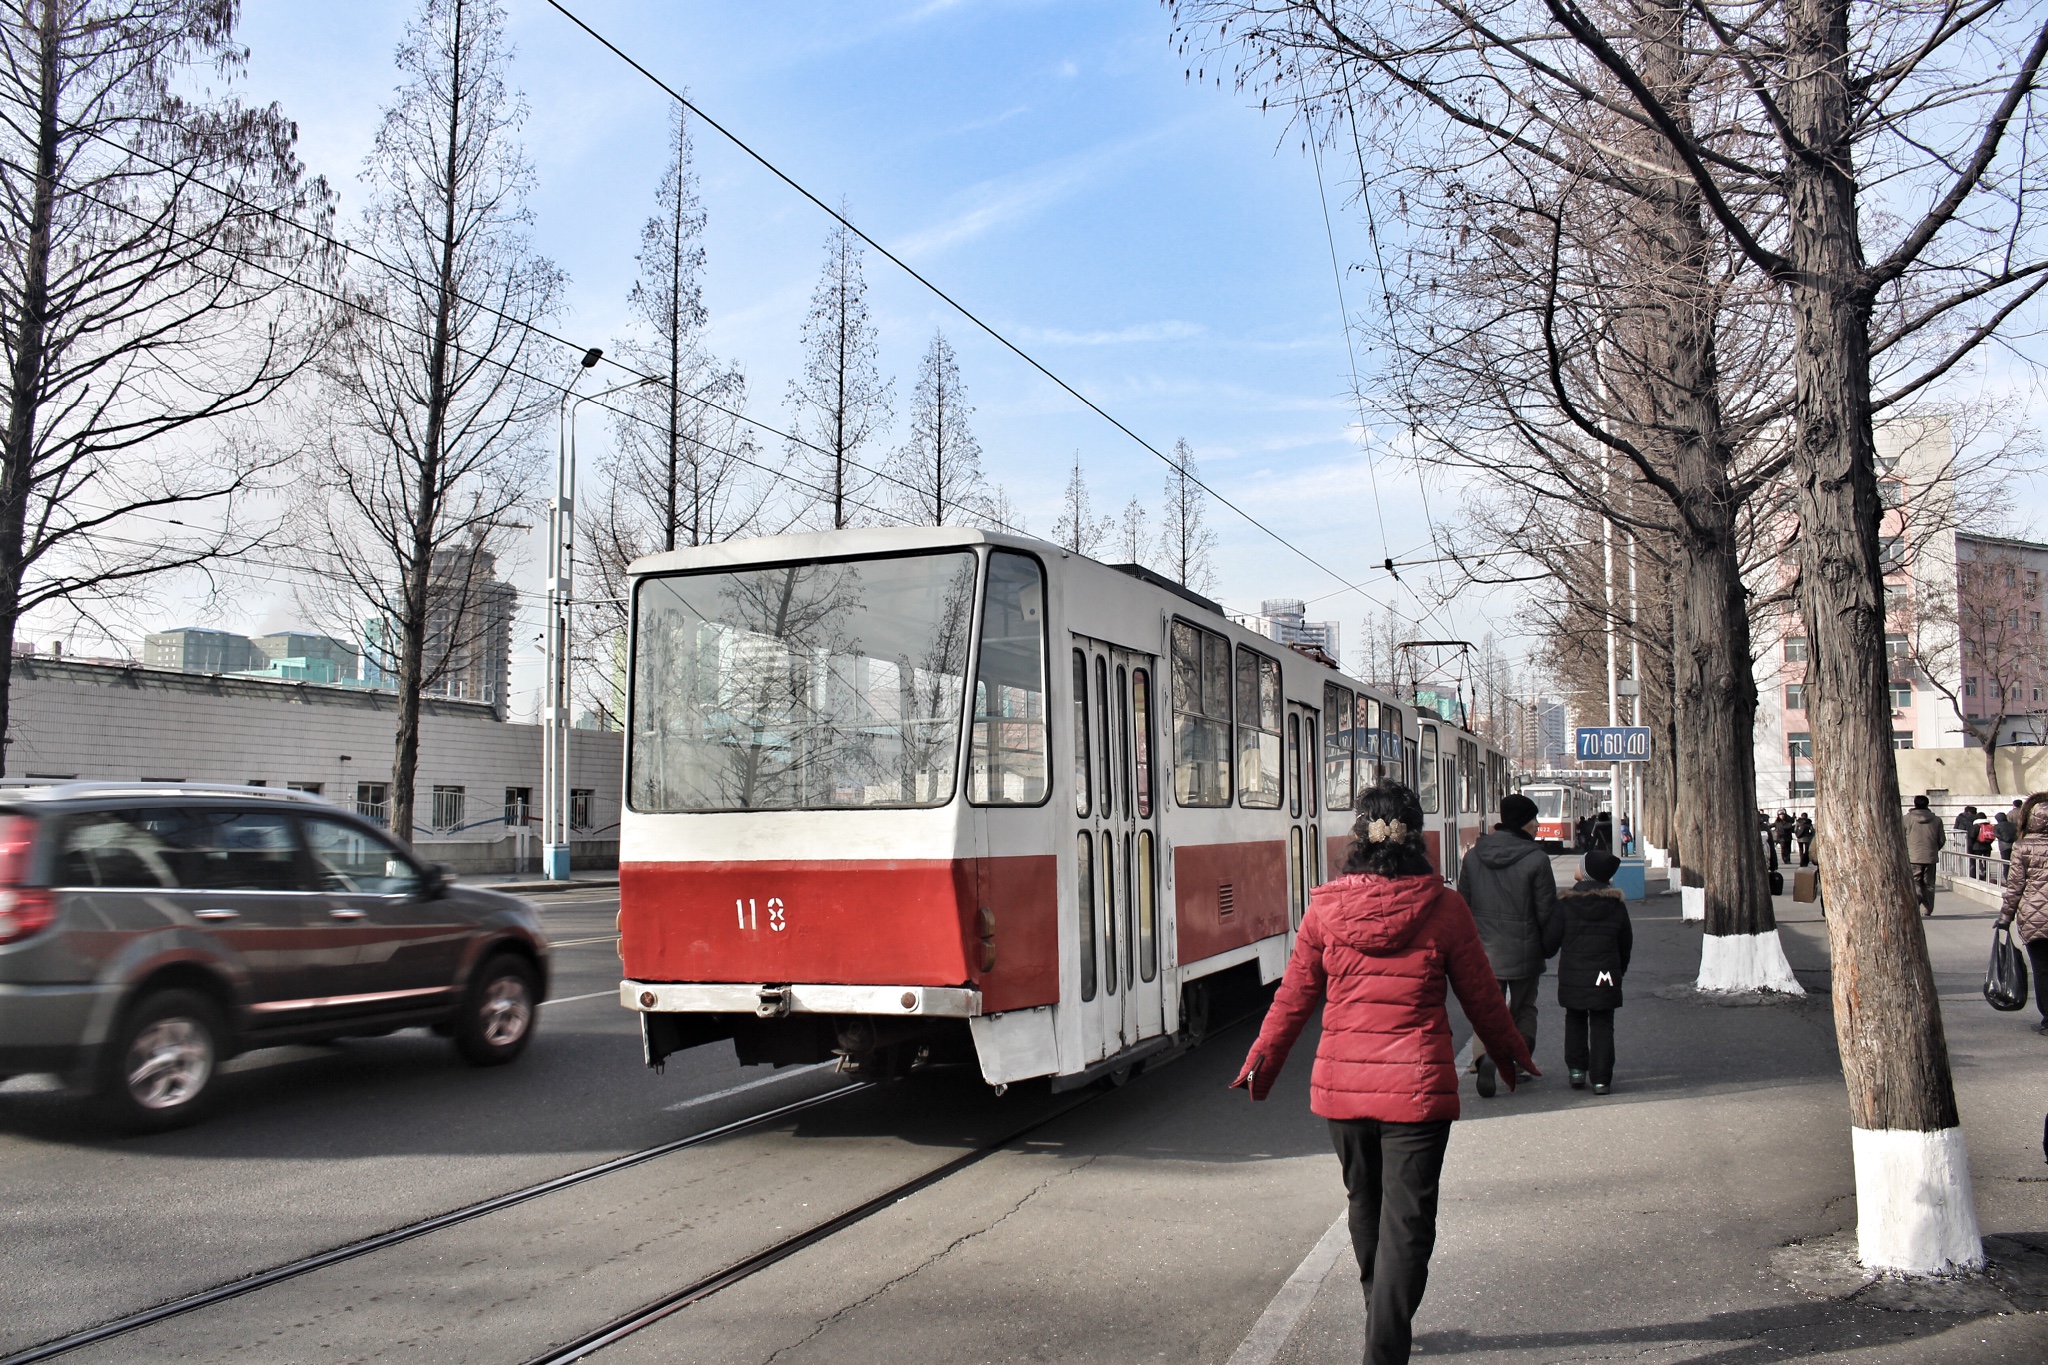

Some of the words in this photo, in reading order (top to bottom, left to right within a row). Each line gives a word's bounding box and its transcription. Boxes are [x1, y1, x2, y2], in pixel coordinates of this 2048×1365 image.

[1581, 733, 1599, 755] 70
[1604, 733, 1622, 755] 60
[1627, 733, 1645, 755] 40
[735, 897, 786, 932] 118
[1595, 970, 1614, 987] M
